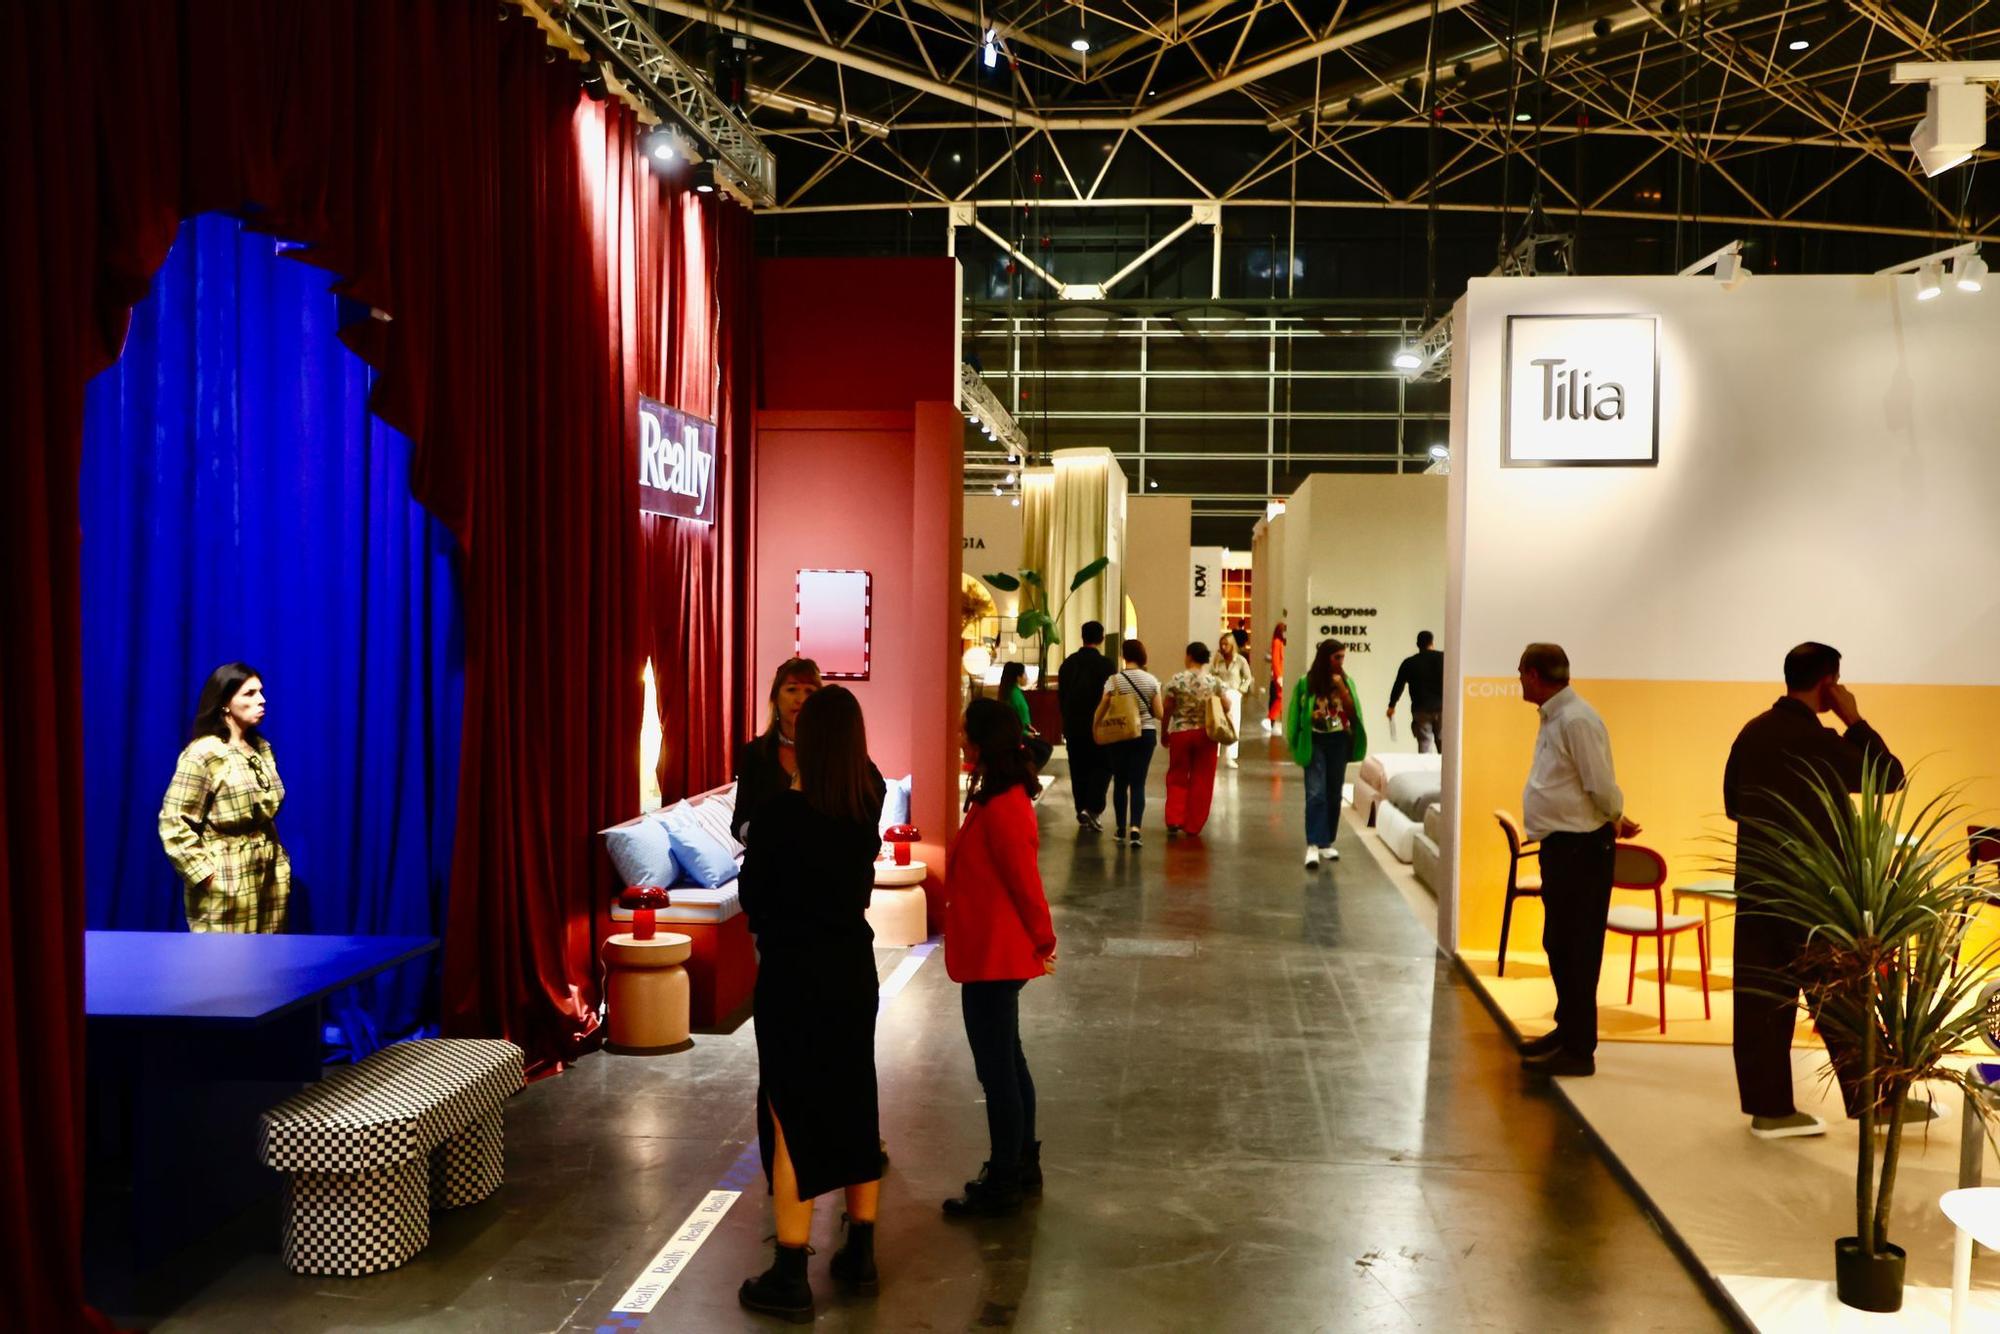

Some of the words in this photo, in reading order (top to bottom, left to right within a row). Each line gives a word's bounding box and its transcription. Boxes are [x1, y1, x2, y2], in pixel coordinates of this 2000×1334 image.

[1530, 358, 1625, 421] Tilia
[639, 410, 712, 515] Really
[1195, 564, 1206, 597] NOW
[1311, 606, 1377, 618] dallagnese
[1468, 682, 1523, 697] CONT
[624, 1282, 664, 1309] Really
[652, 1250, 690, 1274] Really
